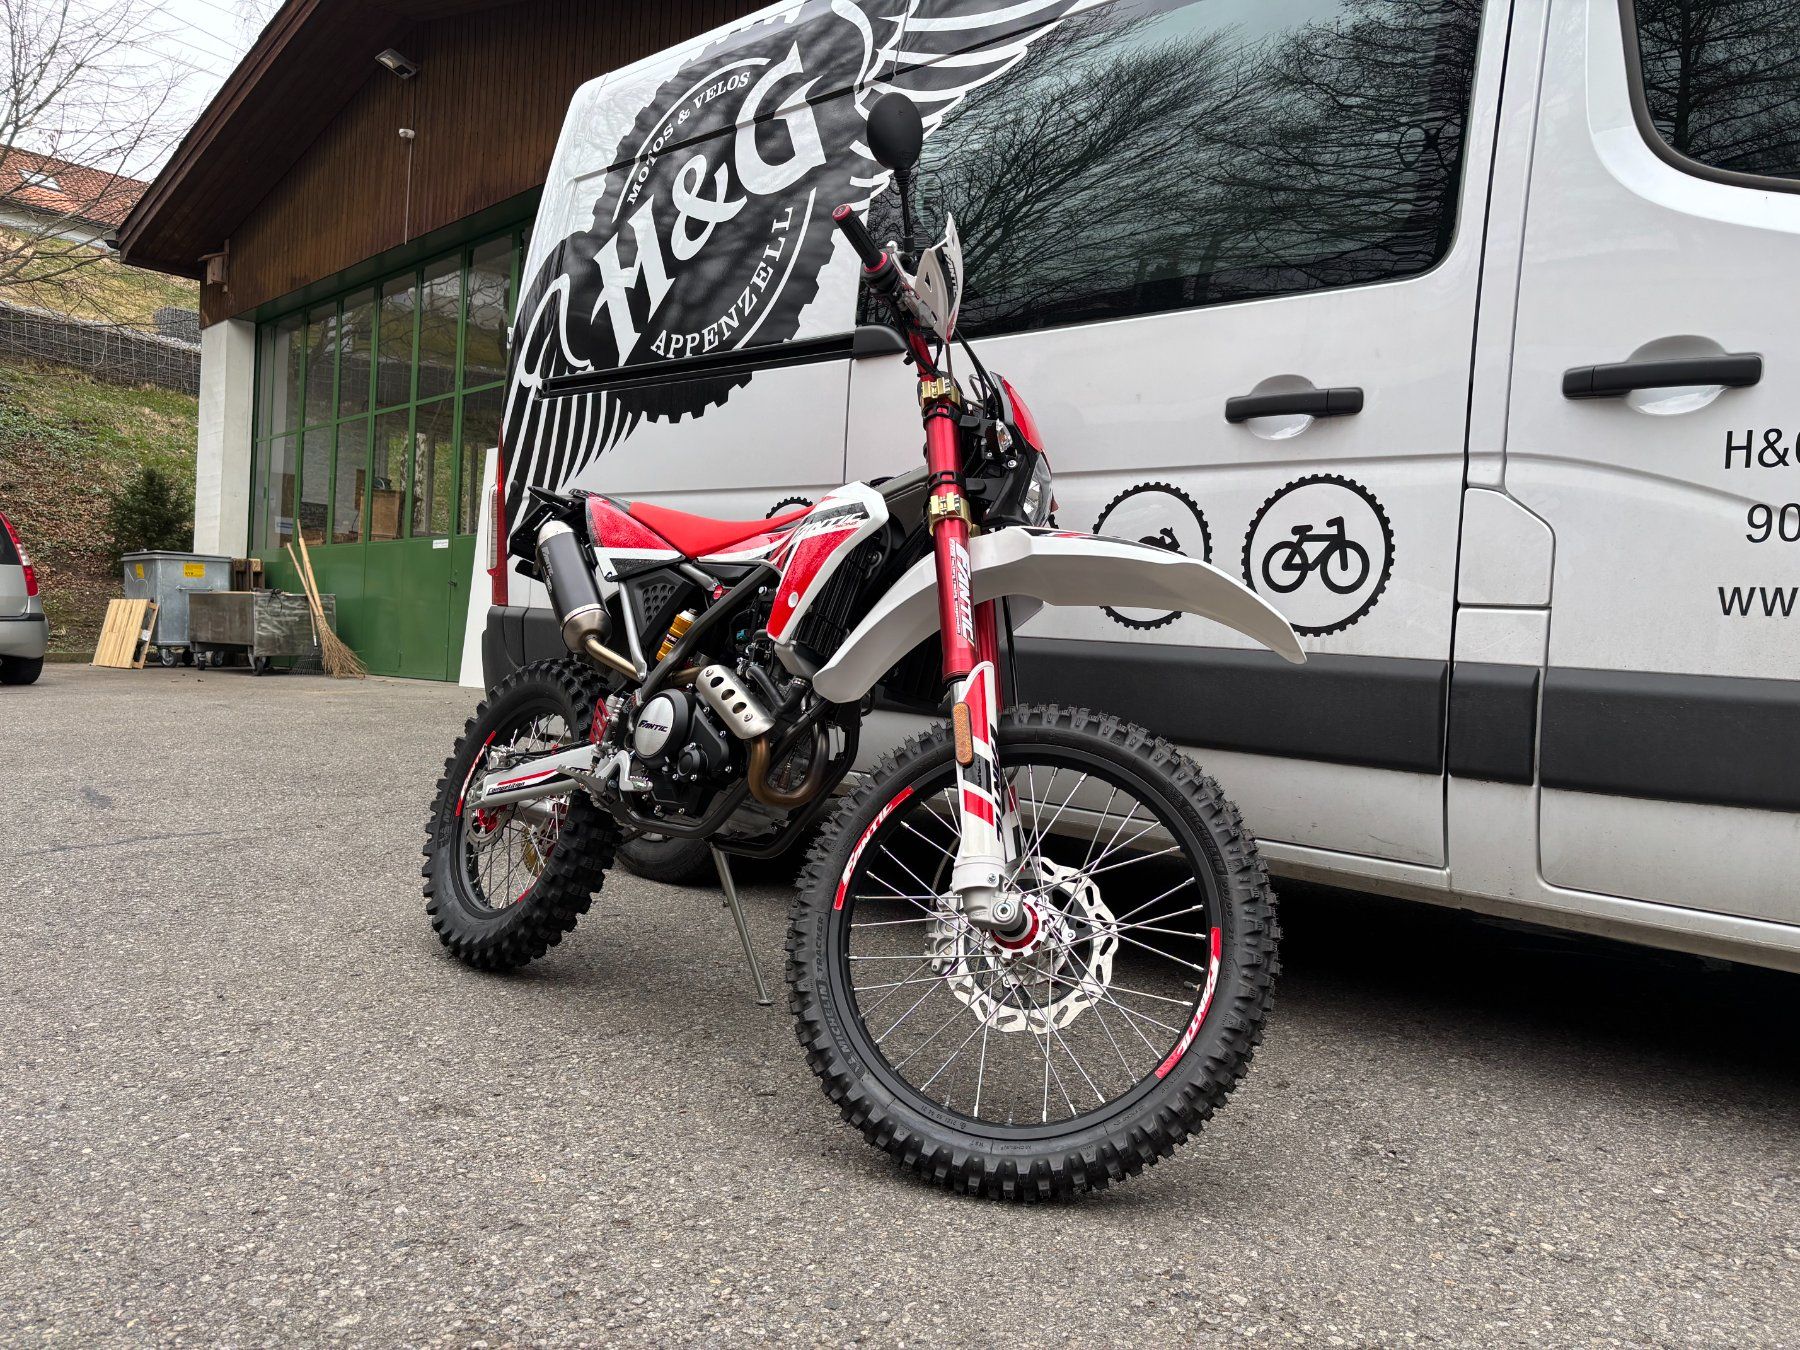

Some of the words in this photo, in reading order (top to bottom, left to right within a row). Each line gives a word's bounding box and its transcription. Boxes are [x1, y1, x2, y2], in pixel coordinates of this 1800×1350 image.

[626, 121, 675, 205] MOTOS
[677, 107, 691, 125] &
[692, 71, 752, 107] VELOS
[590, 40, 827, 368] H&G
[650, 206, 794, 360] APPENZELL
[1724, 428, 1800, 470] H&
[955, 541, 975, 647] FANTIC
[638, 719, 669, 733] FANTIC
[842, 804, 893, 886] FANTIC
[815, 916, 824, 974] TRACKER
[818, 981, 852, 1054] MICHELIN
[1176, 955, 1219, 1056] FANTIC
